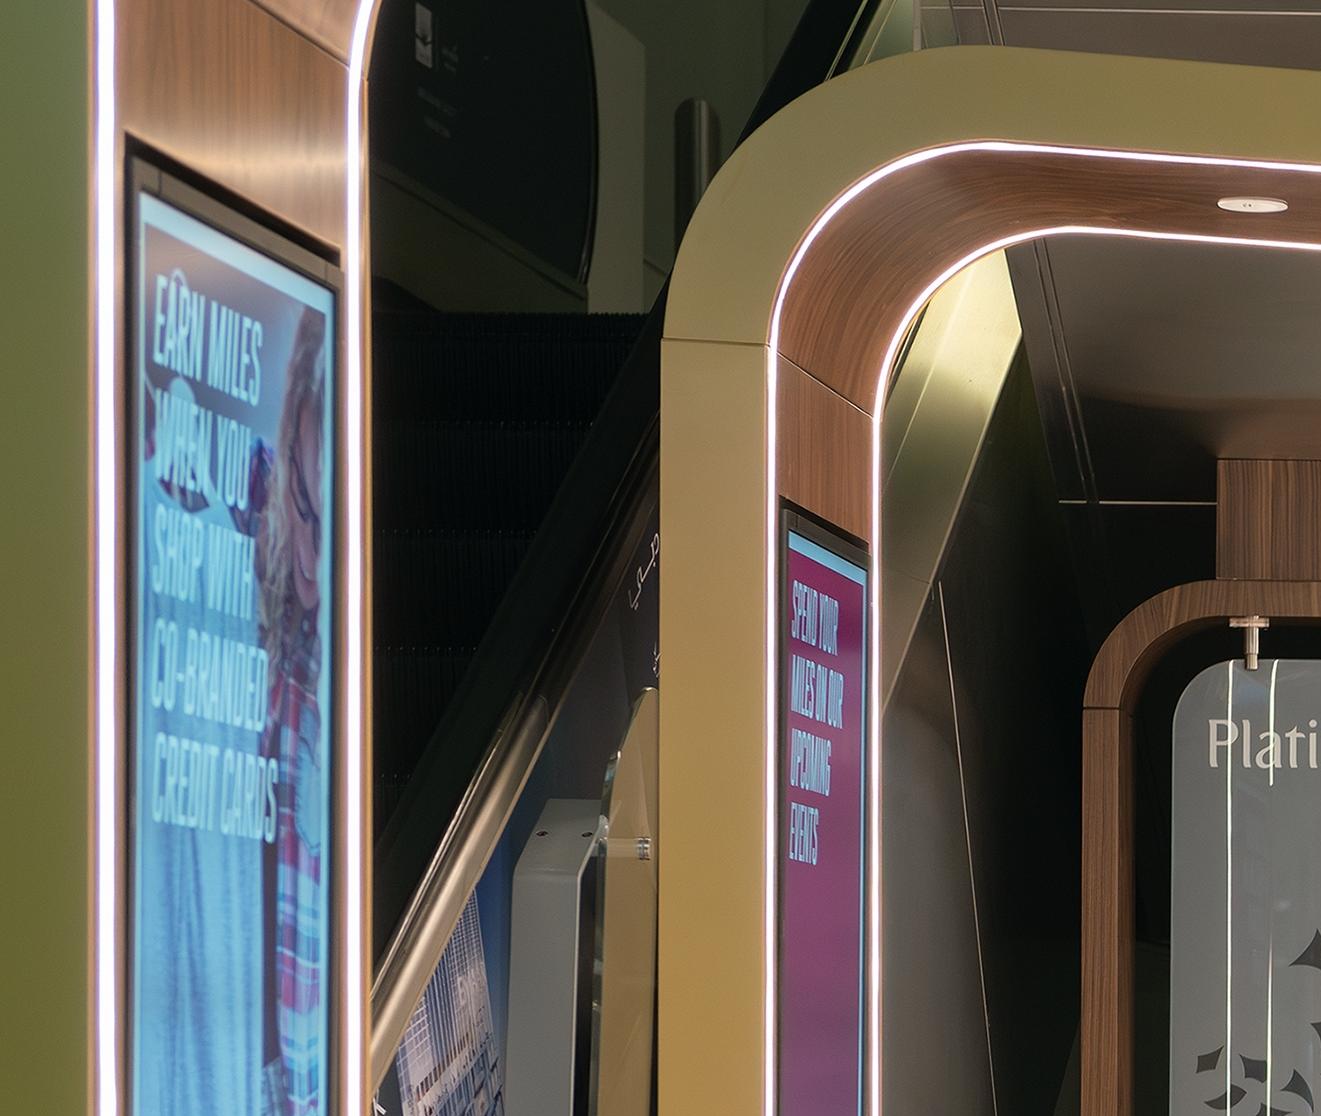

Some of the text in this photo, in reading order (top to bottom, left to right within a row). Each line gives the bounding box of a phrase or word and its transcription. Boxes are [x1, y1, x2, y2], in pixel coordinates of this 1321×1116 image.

[153, 274, 263, 408] EARN MILES
[153, 386, 252, 513] WHEN YOU
[152, 502, 256, 622] SHOP WITH
[791, 579, 839, 656] SPEND YOUR
[151, 617, 269, 734] CO-BRANDED
[791, 654, 844, 729] MILES ON OUR
[151, 731, 279, 844] CREDIT CARDS
[790, 727, 832, 797] UPCOMING
[789, 801, 819, 865] EVENTS
